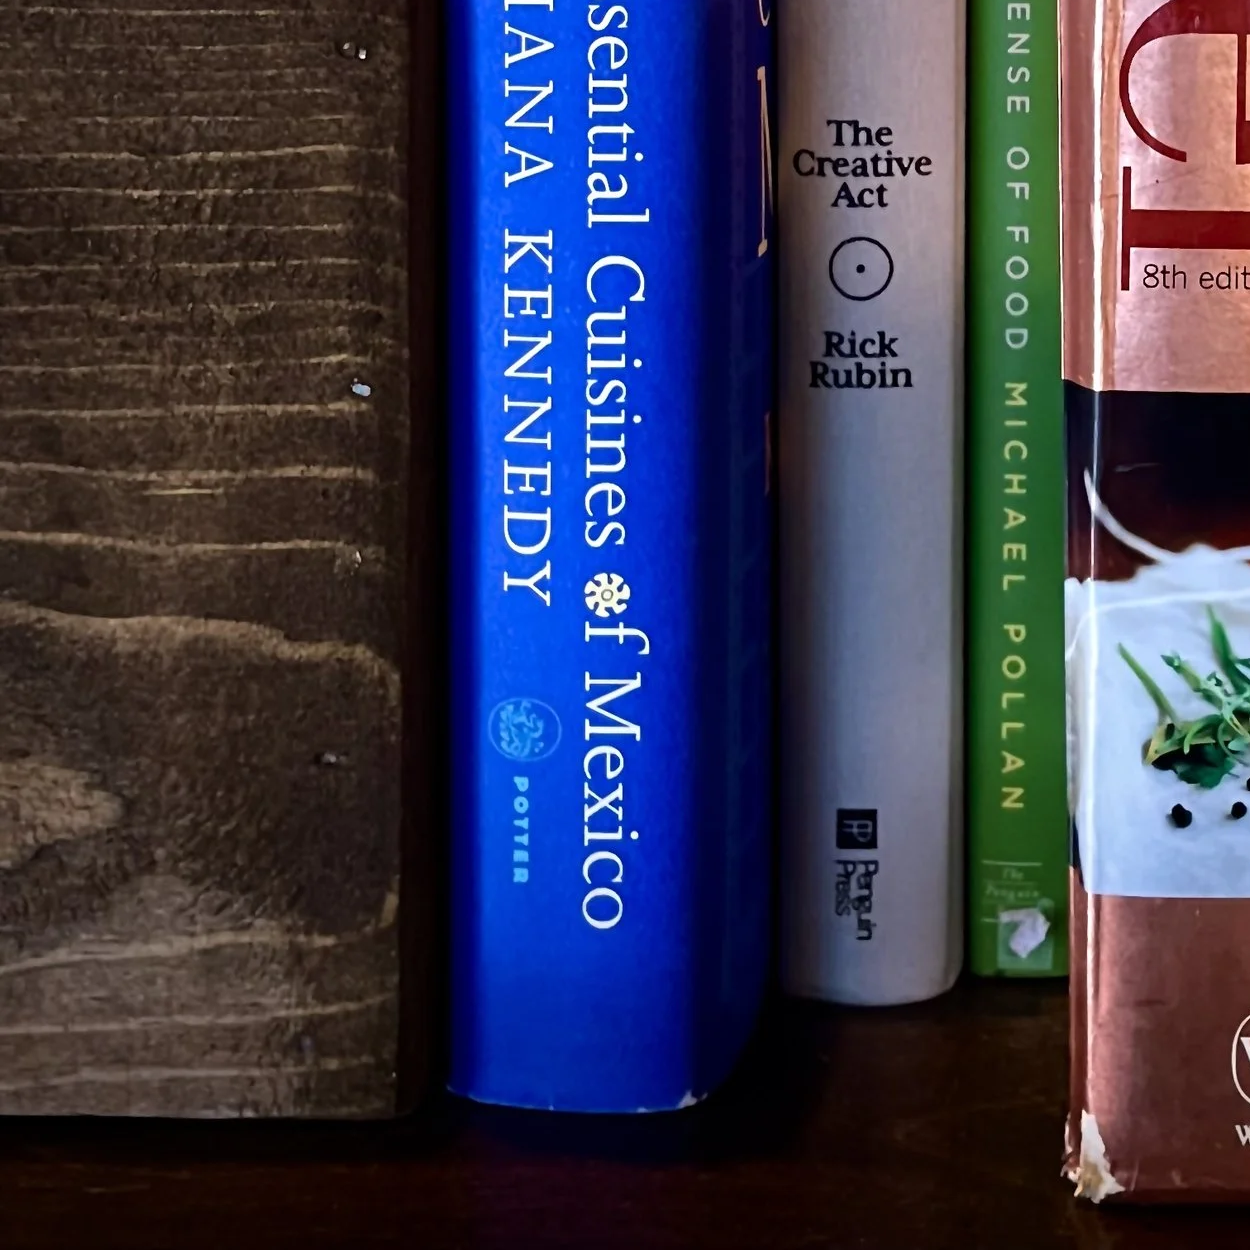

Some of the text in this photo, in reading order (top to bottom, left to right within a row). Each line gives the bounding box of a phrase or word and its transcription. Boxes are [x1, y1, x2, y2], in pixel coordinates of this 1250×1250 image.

[793, 149, 933, 177] Creative
[826, 119, 893, 146] The
[830, 181, 889, 208] Act
[1006, 146, 1030, 200] OF
[1004, 225, 1030, 349] FOOD
[1142, 264, 1188, 290] 8th
[809, 361, 913, 389] Rubin
[822, 330, 899, 359] Rick
[502, 229, 554, 607] KENNEDY
[585, 255, 648, 548] Cuisines
[1002, 382, 1028, 591] MICHAEL
[1001, 623, 1026, 809] POLLAN
[513, 776, 529, 882] POTTER
[582, 671, 642, 930] Mexico
[834, 860, 857, 917] Press
[851, 860, 879, 940] Penguin
